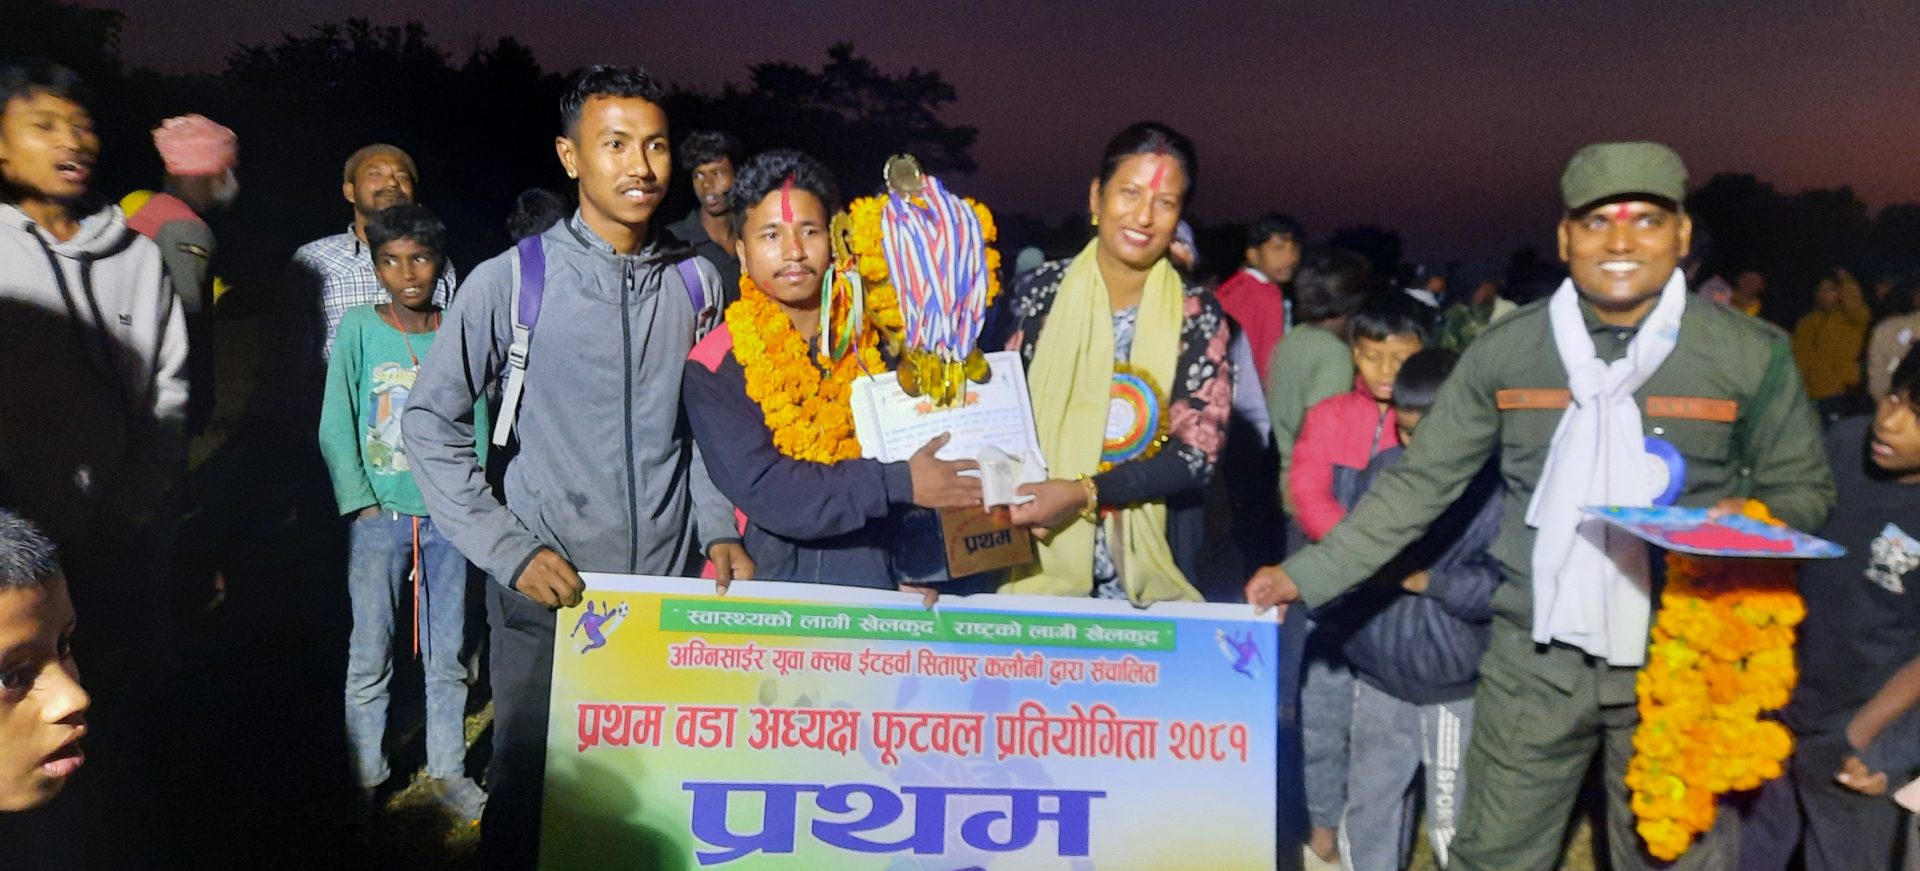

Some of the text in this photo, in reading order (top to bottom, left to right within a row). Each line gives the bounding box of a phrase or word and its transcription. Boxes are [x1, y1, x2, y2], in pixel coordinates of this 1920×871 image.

[687, 609, 792, 628] स्वास्थ्यको
[800, 613, 851, 630] लागी
[859, 614, 935, 636] खेलकुद
[1029, 621, 1077, 640] लागी
[1085, 623, 1158, 646] खेलकुद
[773, 650, 804, 676] यूवा
[811, 652, 852, 672] क्लब
[918, 649, 979, 682] सितापुर
[1050, 660, 1084, 685] द्वारा
[1090, 656, 1158, 684] संचालित
[577, 701, 1247, 765] प्रथम वडा अध्यक्ष फूटवल प्रतियोगिता २०८१
[682, 782, 1107, 866] प्रथम
